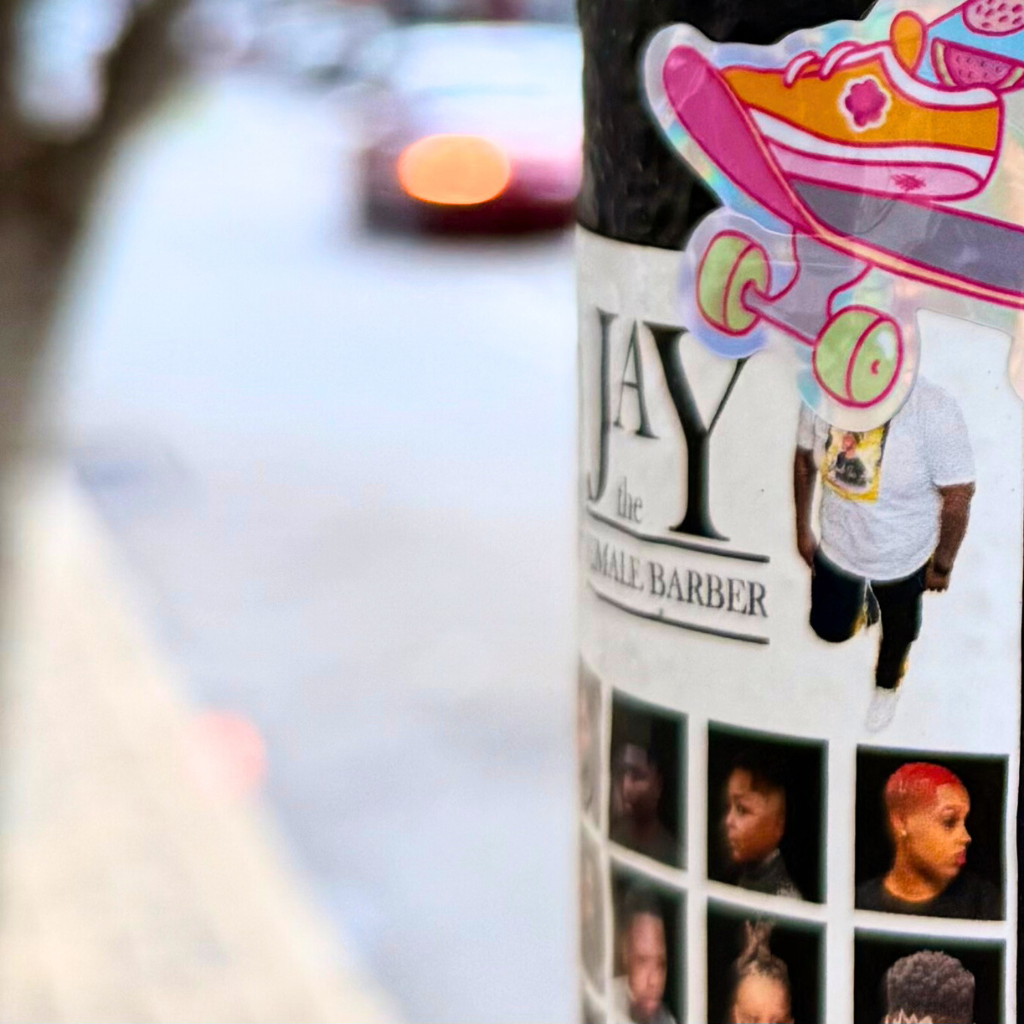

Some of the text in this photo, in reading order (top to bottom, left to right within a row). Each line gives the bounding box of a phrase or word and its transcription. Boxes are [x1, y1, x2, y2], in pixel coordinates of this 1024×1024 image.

[586, 307, 760, 541] JAY
[618, 476, 643, 524] the
[648, 561, 769, 618] BARBER
